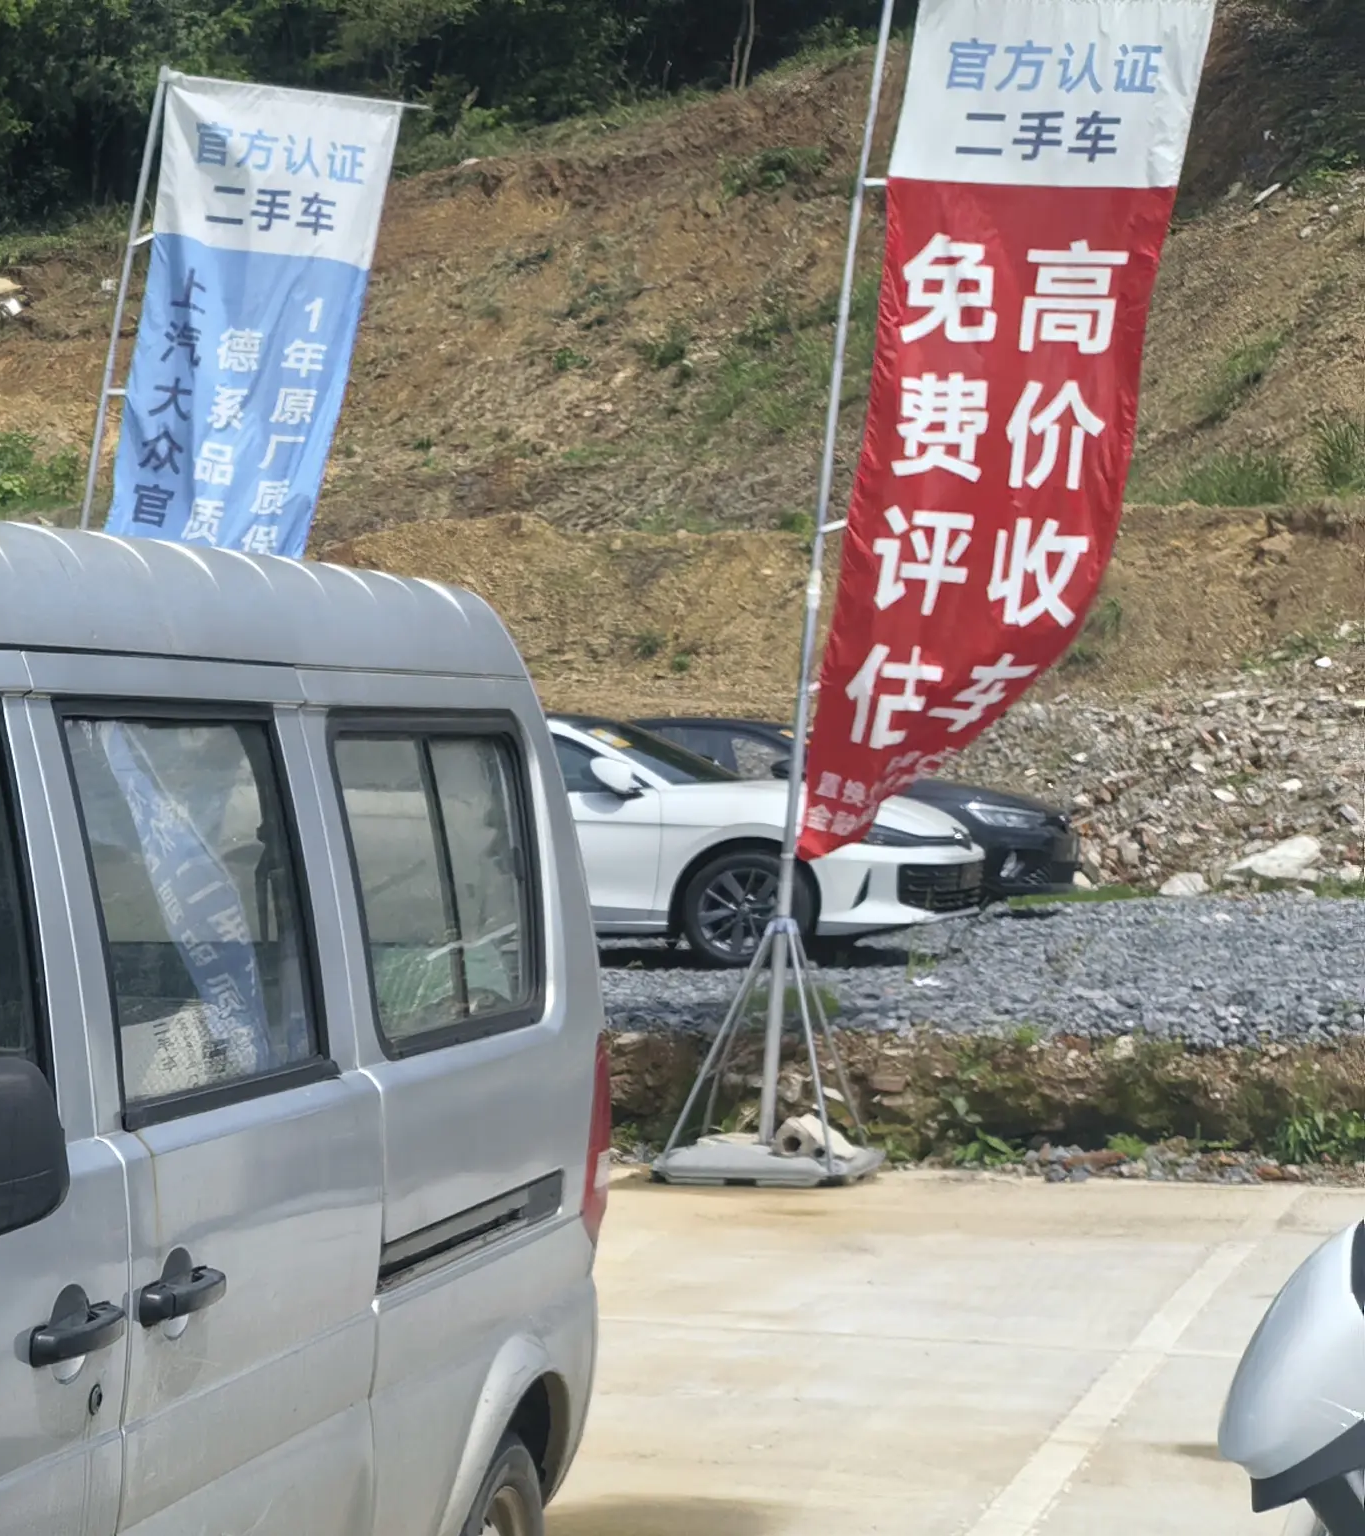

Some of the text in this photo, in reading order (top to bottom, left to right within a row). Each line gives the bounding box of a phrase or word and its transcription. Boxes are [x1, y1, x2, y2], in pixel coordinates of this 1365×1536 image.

[945, 38, 1163, 95] 官方认证
[195, 122, 366, 186] 官方认证
[955, 110, 1122, 163] 二手车
[205, 184, 337, 236] 二手车
[181, 326, 263, 546] 德系品质
[845, 232, 998, 750] 免费评估
[928, 240, 1130, 733] 高价收车
